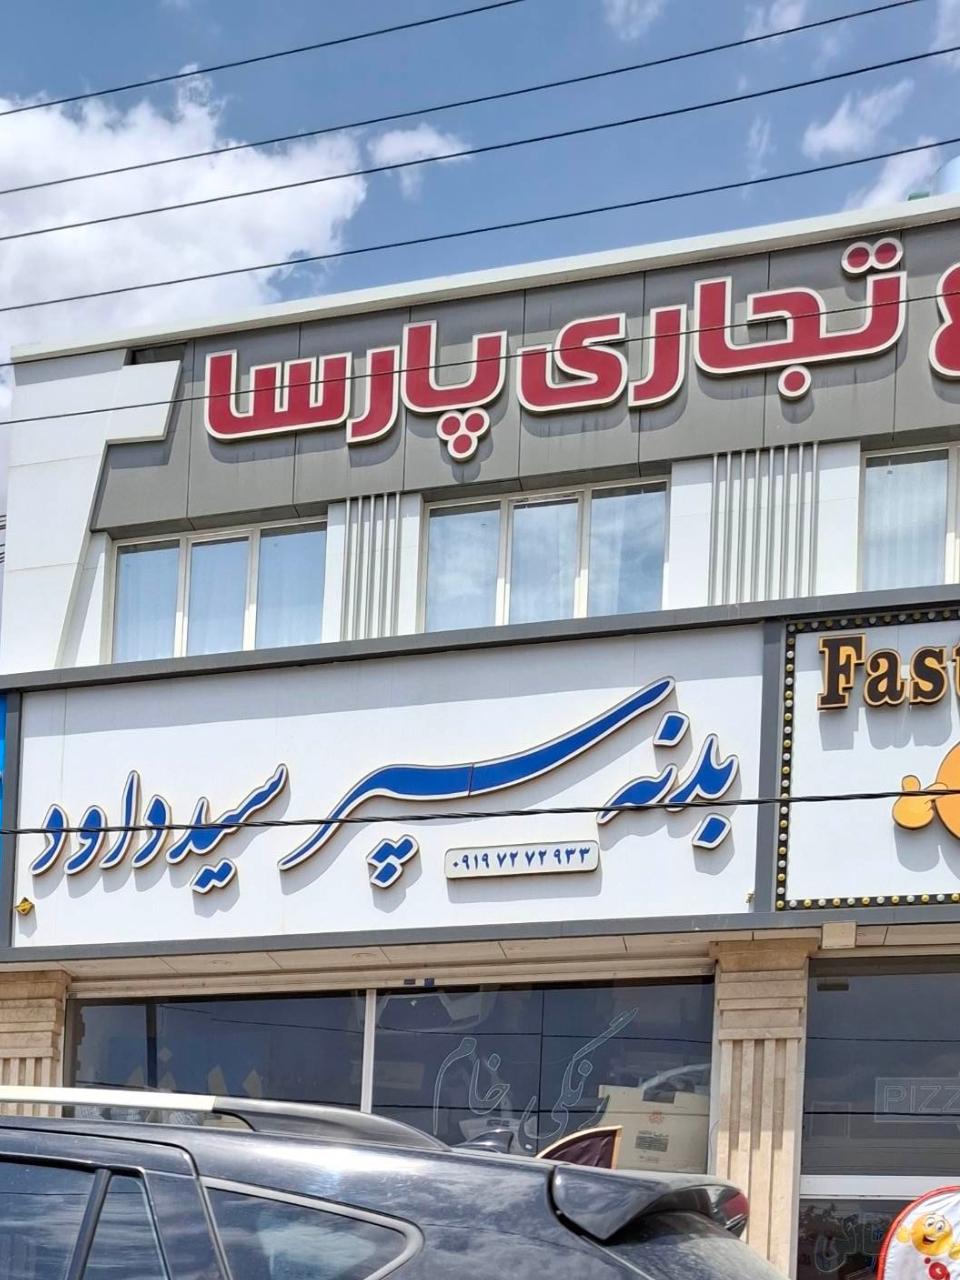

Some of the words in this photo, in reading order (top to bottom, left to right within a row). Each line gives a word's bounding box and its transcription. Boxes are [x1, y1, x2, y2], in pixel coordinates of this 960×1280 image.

[204, 320, 508, 462] پارسا
[517, 236, 908, 412] تجاری
[816, 633, 960, 711] Fas
[277, 675, 677, 890] سپر
